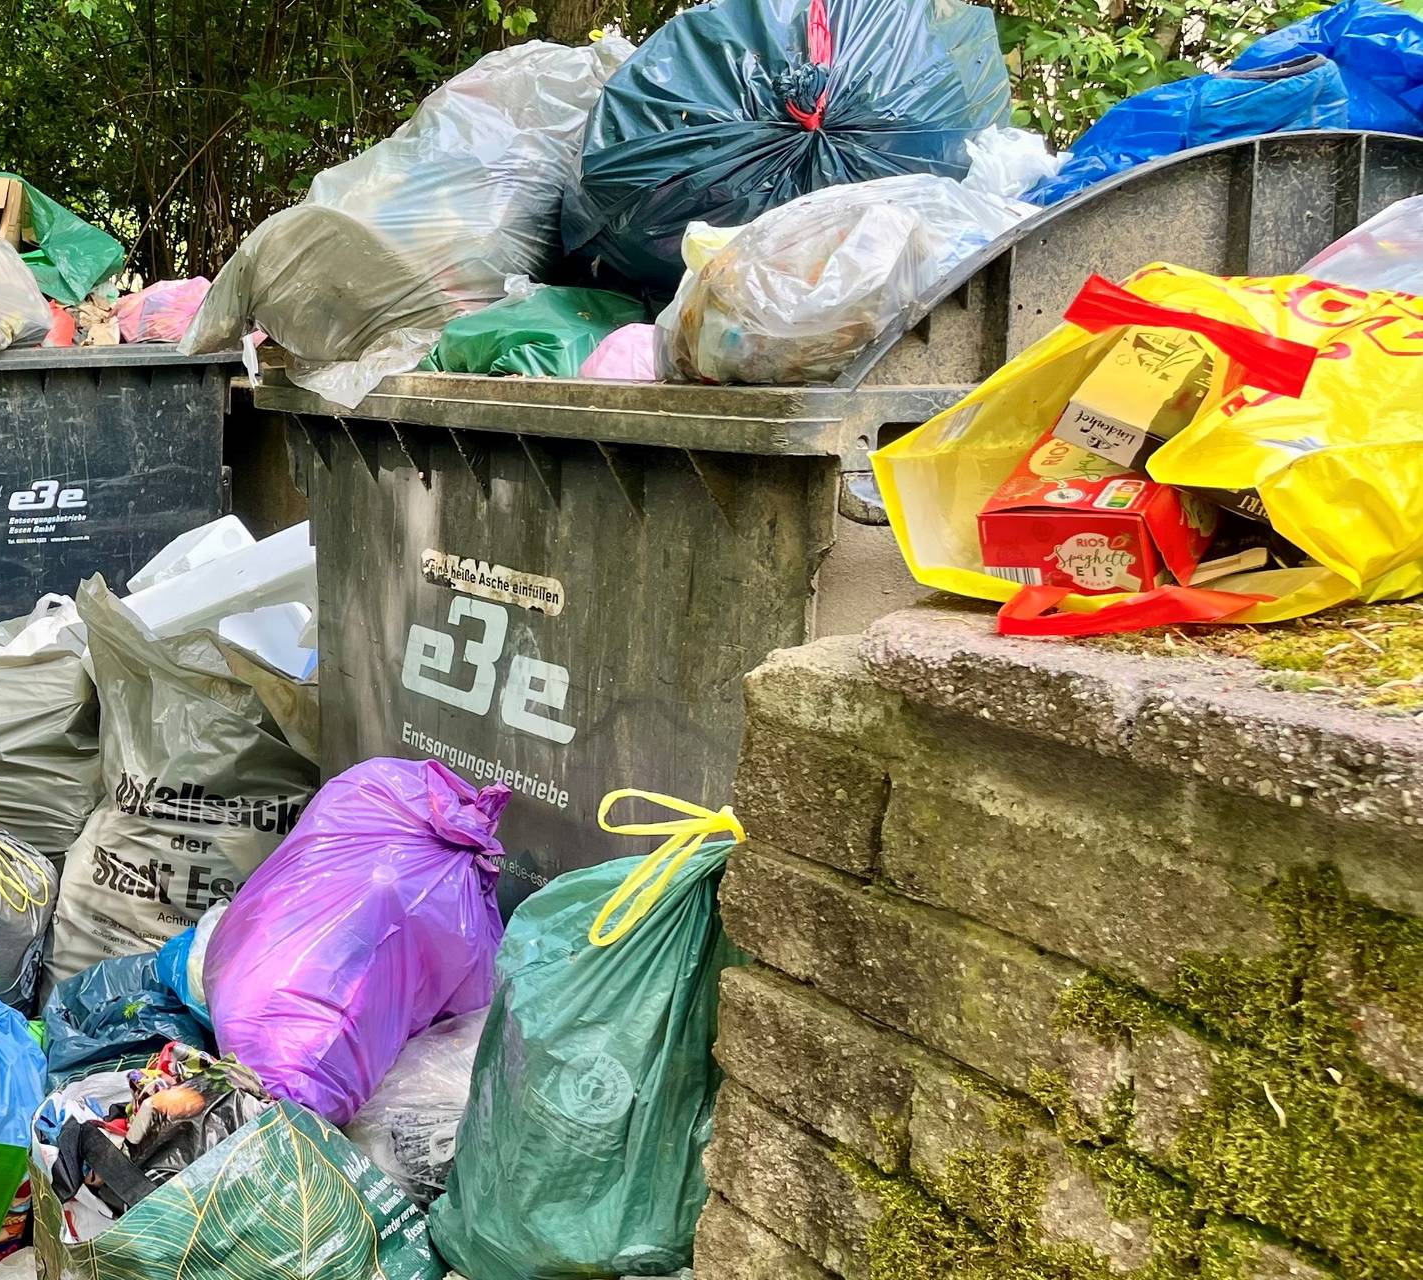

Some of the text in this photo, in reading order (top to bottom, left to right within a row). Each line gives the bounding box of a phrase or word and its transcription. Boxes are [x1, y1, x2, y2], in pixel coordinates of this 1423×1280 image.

[8, 480, 87, 511] e3e
[9, 513, 87, 525] Entsorgungsbetriebe
[9, 525, 56, 535] Essen GmbH
[1077, 538, 1106, 548] RIOS
[1057, 548, 1133, 569] Spaghetti
[450, 565, 477, 584] heiße
[478, 572, 510, 592] Asche
[512, 583, 559, 604] einfüllen
[401, 595, 576, 745] e3e
[401, 721, 570, 809] Entsorgungsbetriebe
[170, 834, 212, 855] der
[157, 912, 198, 928] Achtun
